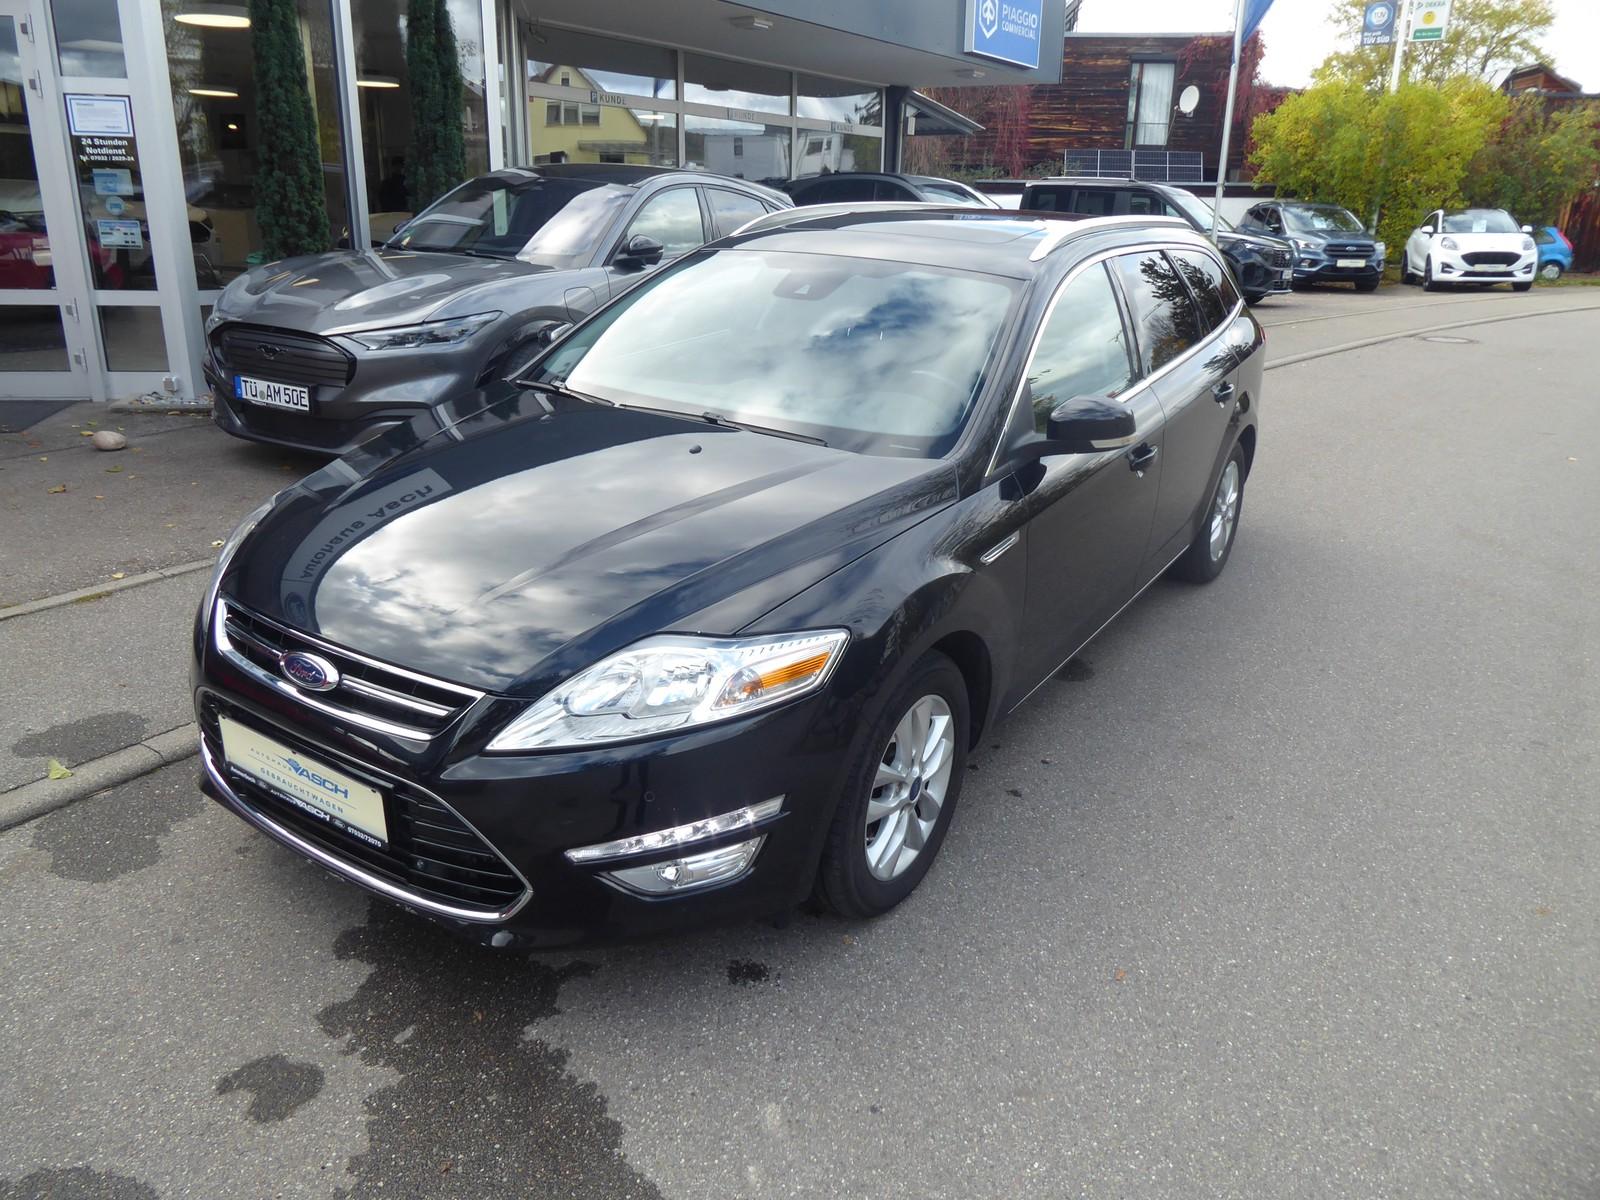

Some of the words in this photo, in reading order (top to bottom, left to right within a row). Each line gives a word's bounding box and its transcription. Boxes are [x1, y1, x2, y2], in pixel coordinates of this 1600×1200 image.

[1002, 4, 1038, 28] PIAGGIO
[1002, 21, 1036, 40] COMMERCIAL
[86, 147, 127, 155] Notdienst
[94, 138, 128, 146] Stunden
[241, 379, 258, 399] TÜ
[266, 384, 282, 403] AM
[283, 387, 308, 408] 50E
[260, 767, 344, 814] GEBRAUCHTWAGEN
[298, 768, 349, 800] ASCH
